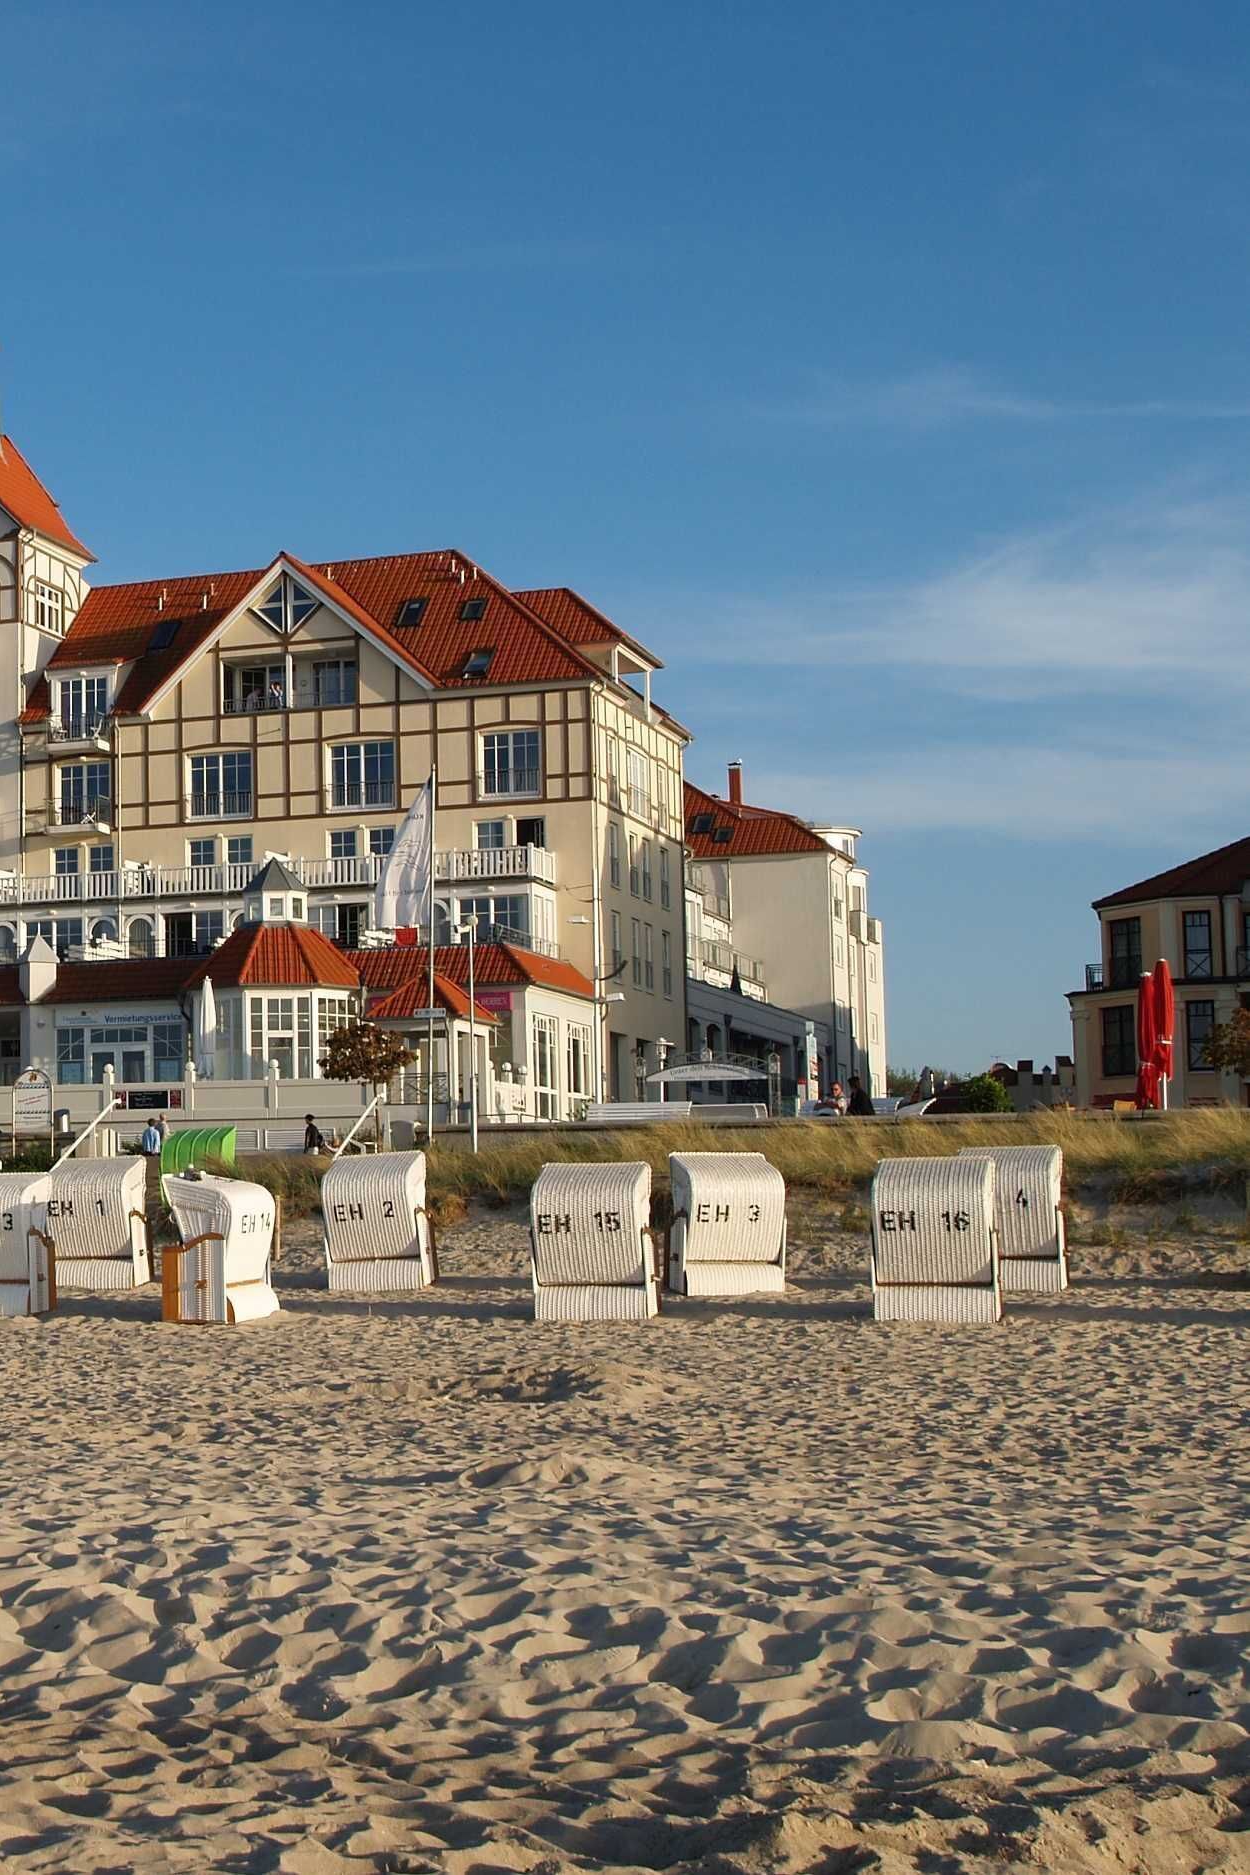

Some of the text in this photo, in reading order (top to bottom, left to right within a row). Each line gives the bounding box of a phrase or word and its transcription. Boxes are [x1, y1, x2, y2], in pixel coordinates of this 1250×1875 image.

[47, 1199, 104, 1217] EH 1
[333, 1200, 395, 1222] EH 2
[697, 1204, 761, 1223] EH 3
[241, 1212, 271, 1233] EH 14
[537, 1211, 621, 1234] EH 15
[880, 1210, 970, 1231] EH 16
